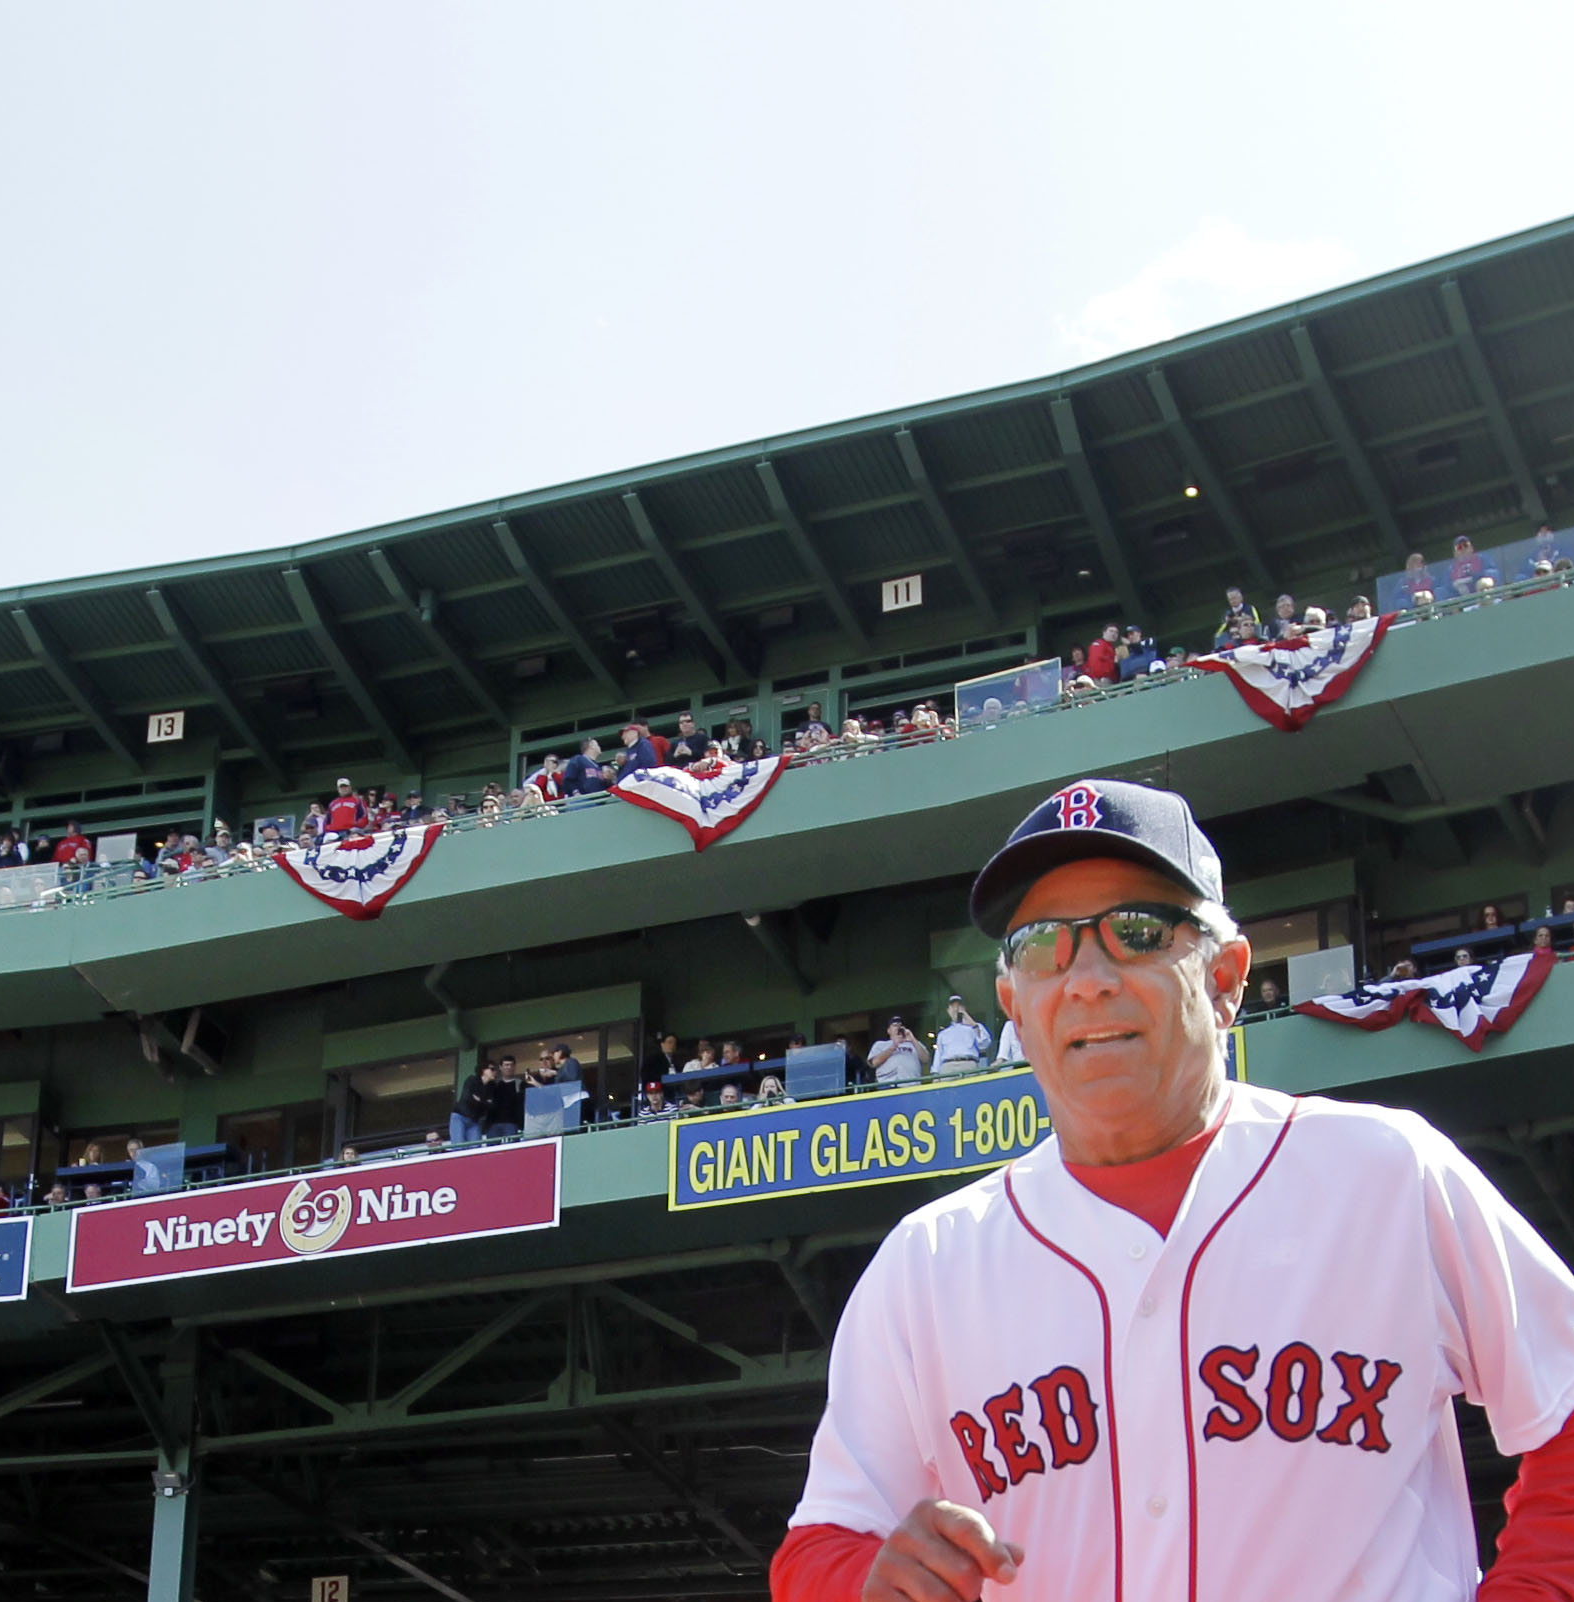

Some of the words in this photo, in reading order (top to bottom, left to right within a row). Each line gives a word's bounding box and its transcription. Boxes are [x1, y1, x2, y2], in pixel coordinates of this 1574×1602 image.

[894, 582, 911, 605] 11
[157, 717, 176, 738] 13
[1052, 785, 1103, 830] B
[688, 1128, 800, 1194] GIANT
[810, 1110, 937, 1177] GLASS
[143, 1208, 276, 1255] Ninety
[356, 1184, 458, 1225] Nine
[950, 1364, 1100, 1503] RED
[1199, 1341, 1403, 1454] SOX
